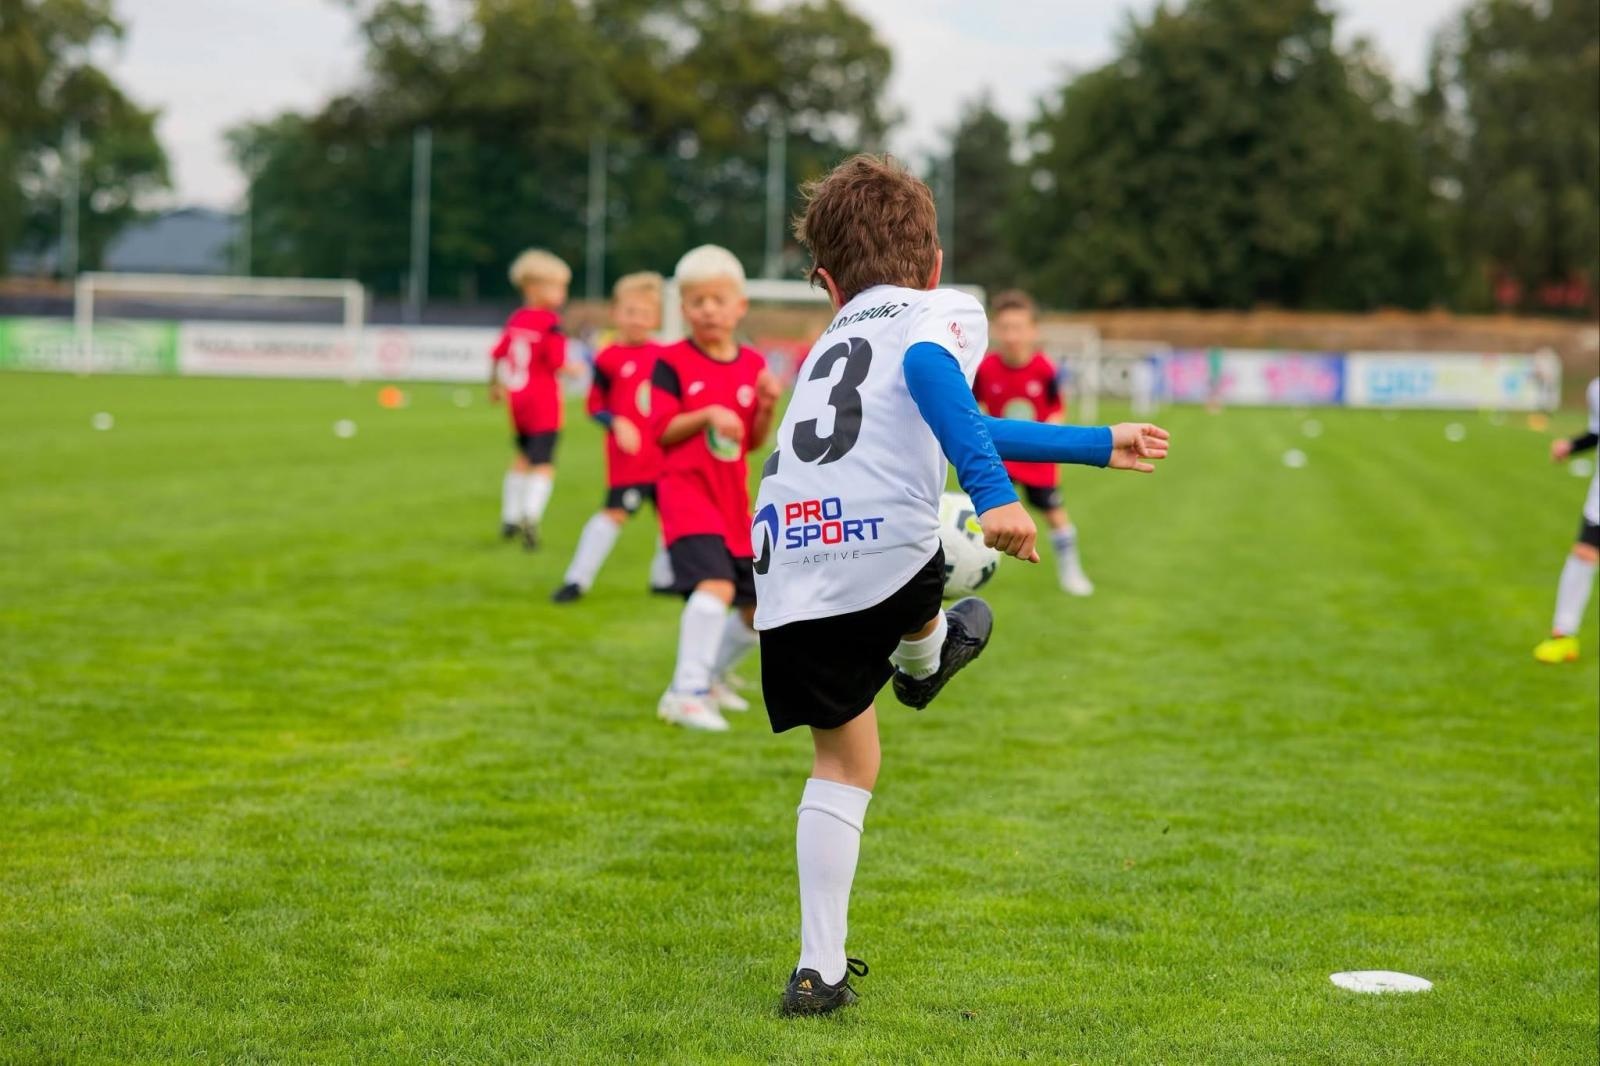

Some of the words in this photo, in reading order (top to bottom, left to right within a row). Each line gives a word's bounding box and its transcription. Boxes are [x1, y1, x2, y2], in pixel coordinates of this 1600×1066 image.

[785, 497, 842, 526] PRO
[785, 517, 884, 549] SPORT
[802, 551, 860, 565] ACTIVE
